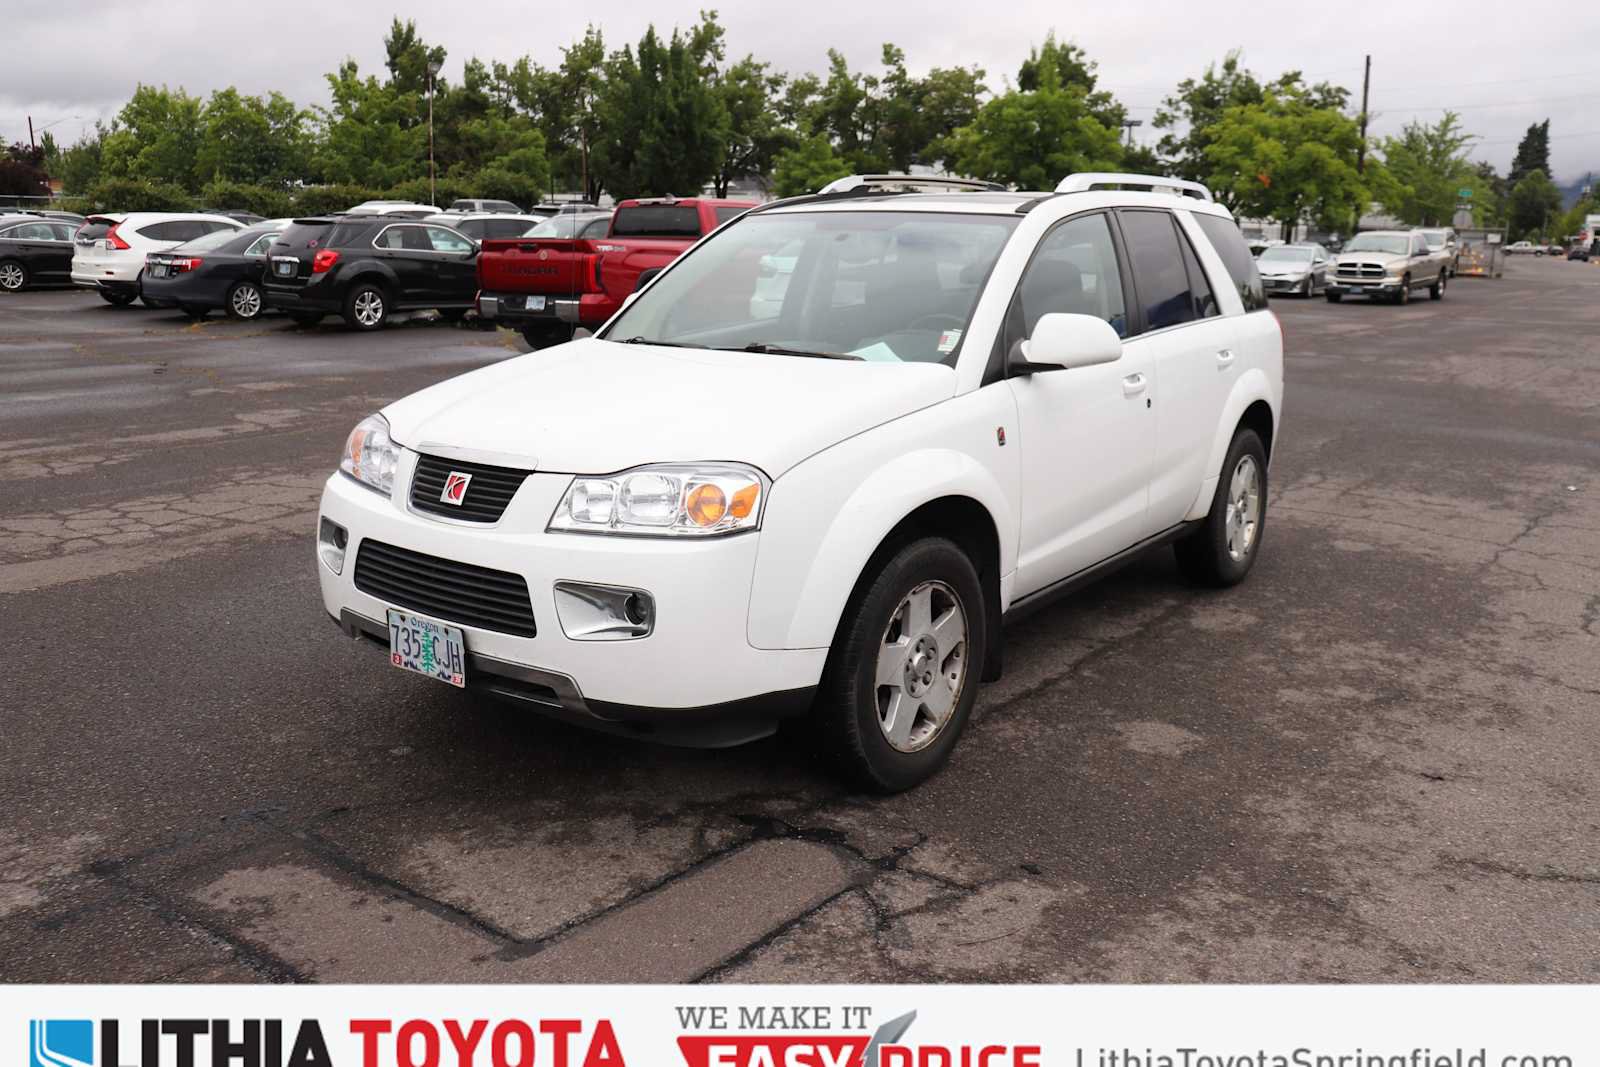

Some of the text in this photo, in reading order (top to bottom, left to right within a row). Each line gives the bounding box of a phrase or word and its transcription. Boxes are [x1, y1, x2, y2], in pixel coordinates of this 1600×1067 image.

[410, 616, 439, 633] Oregon
[391, 623, 462, 674] 735 CJH
